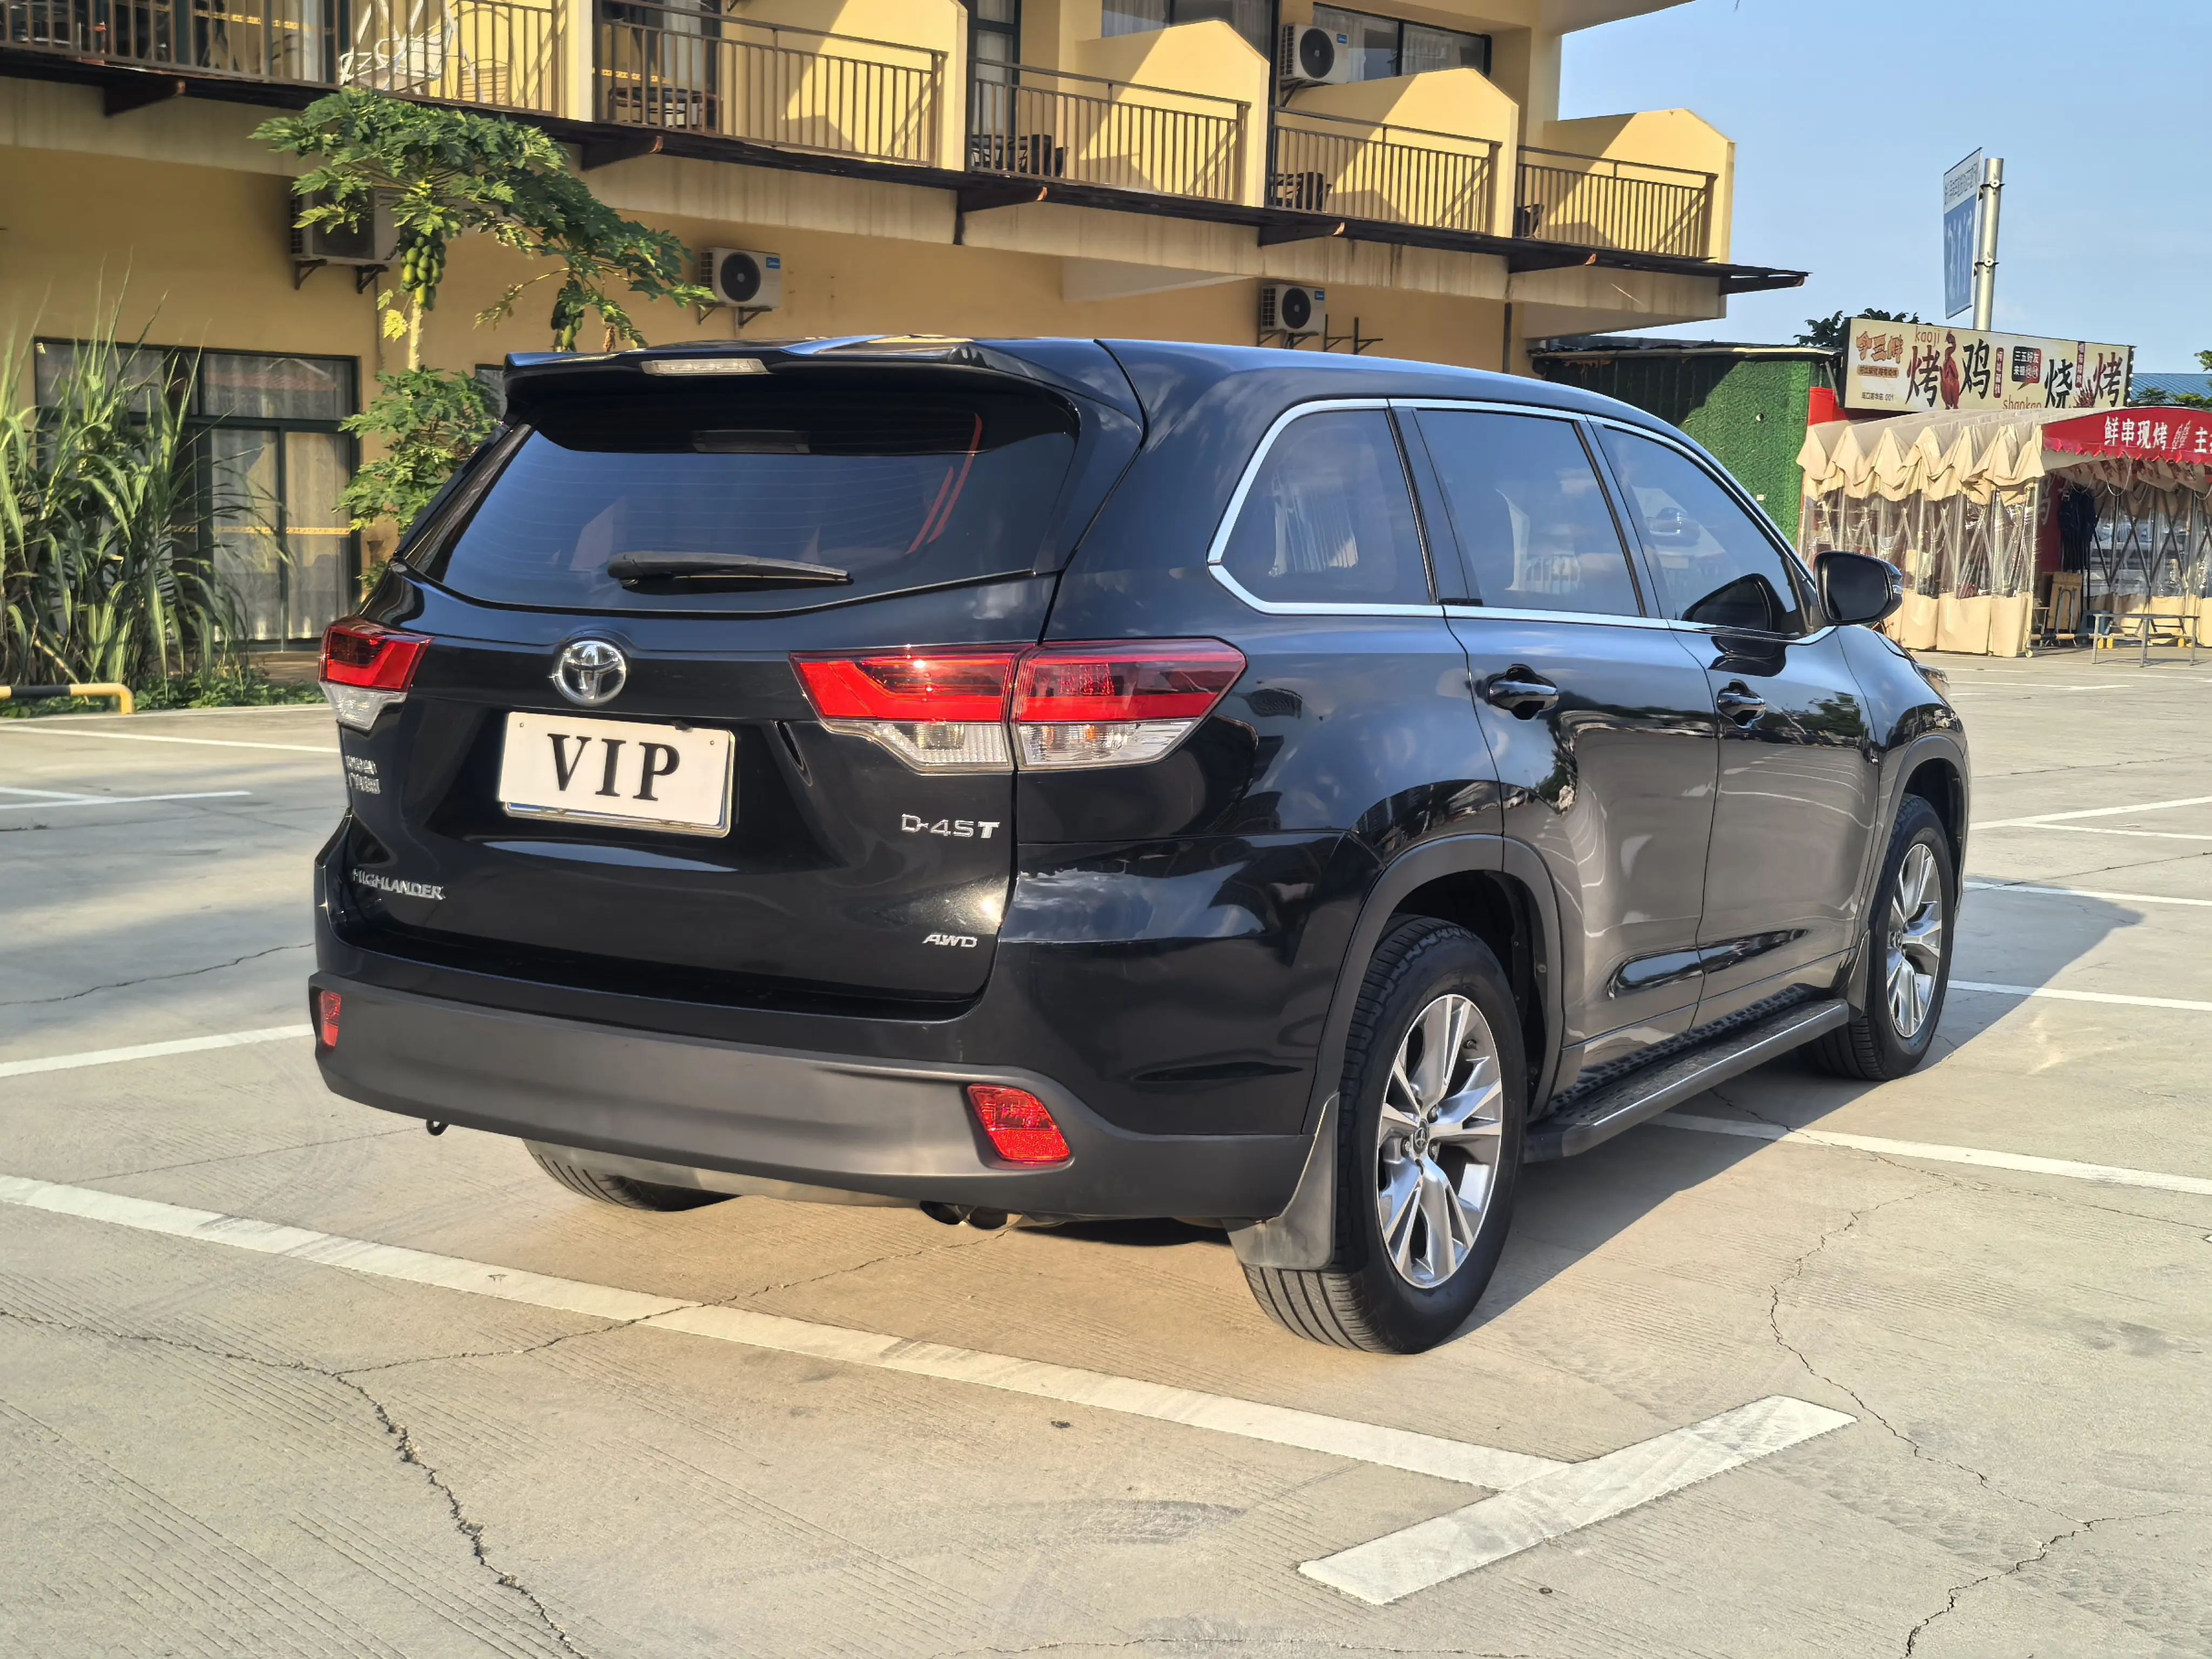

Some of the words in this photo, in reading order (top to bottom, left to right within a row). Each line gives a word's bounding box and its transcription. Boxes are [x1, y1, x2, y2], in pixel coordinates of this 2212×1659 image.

[2045, 352, 2123, 409] 烧烤
[2104, 416, 2168, 450] 鲜串现烤
[2194, 427, 2212, 453] 主
[547, 733, 680, 802] VIP
[353, 868, 446, 900] HIGHLANDER
[922, 933, 978, 948] AWD
